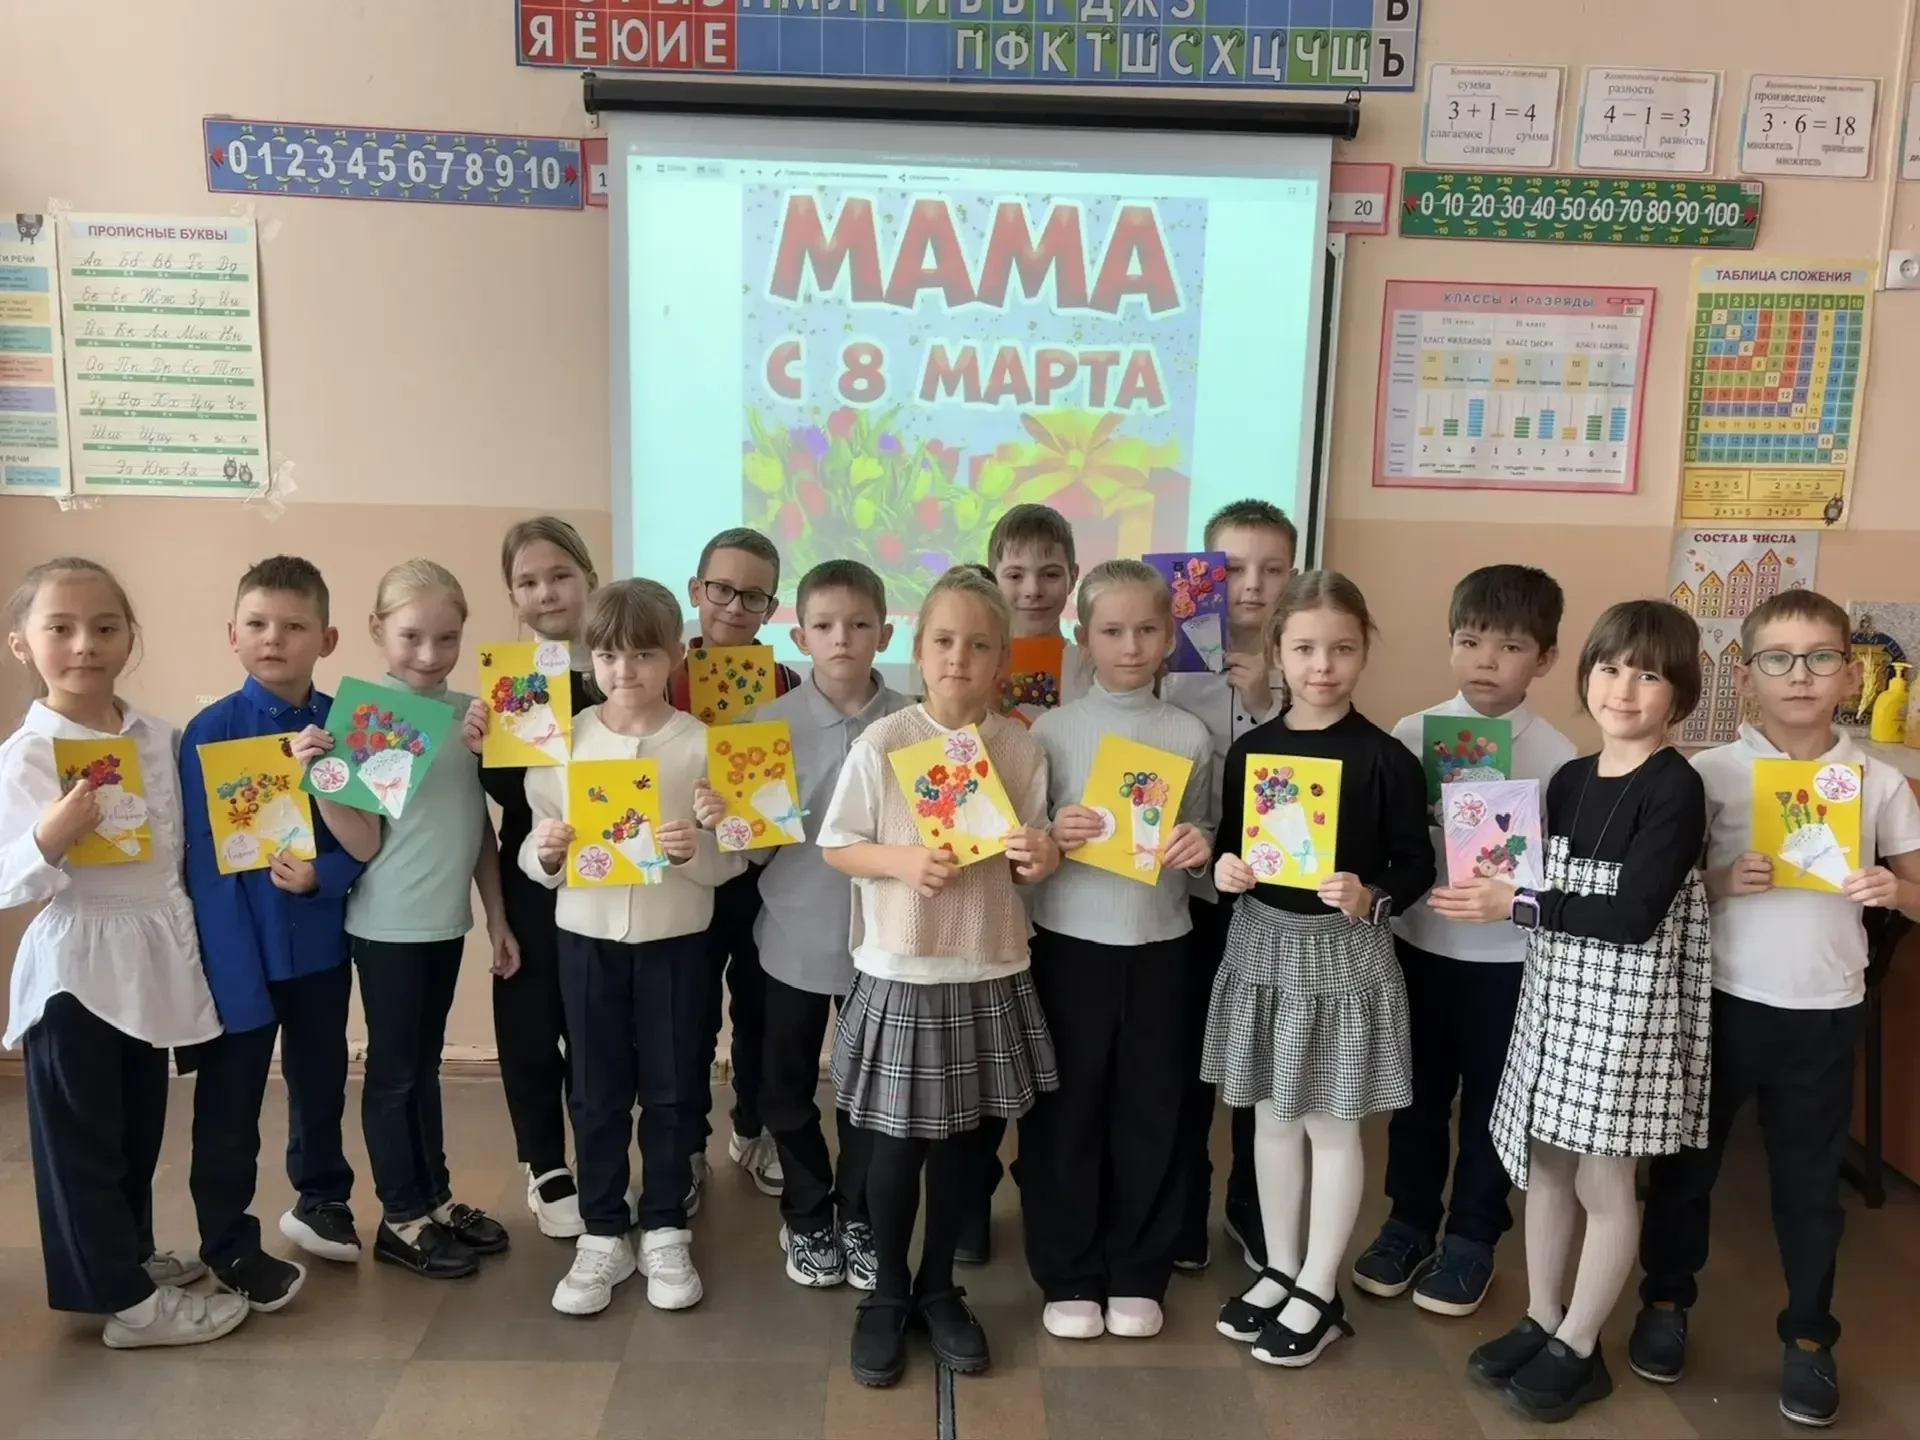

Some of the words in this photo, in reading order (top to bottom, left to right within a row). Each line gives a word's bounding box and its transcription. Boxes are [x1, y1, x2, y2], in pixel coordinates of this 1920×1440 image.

[528, 15, 554, 57] Я
[574, 11, 597, 59] Ё
[612, 20, 649, 62] Ю
[657, 20, 687, 62] И
[704, 22, 727, 64] Е
[956, 29, 983, 71] П
[994, 30, 1030, 72] Ф
[1042, 32, 1070, 73] К
[1086, 32, 1112, 73] Т
[1121, 33, 1157, 74] Ш
[1168, 33, 1197, 76] С
[1207, 34, 1239, 76] Х
[1252, 35, 1281, 82] Ц
[1295, 35, 1320, 77] Ч
[1331, 36, 1370, 83] Щ
[1378, 38, 1405, 77] Ъ
[1457, 80, 1491, 91] сумма
[1608, 85, 1654, 95] разность
[1754, 92, 1826, 103] произведение
[1430, 129, 1483, 139] слагаемое
[1516, 132, 1550, 142] сумма
[1463, 145, 1516, 155] слагаемое
[1613, 150, 1676, 160] вычитаемое
[228, 140, 247, 174] 0
[258, 142, 272, 175] 1
[286, 143, 306, 177] 2
[316, 145, 336, 178] 3
[347, 147, 366, 179] 4
[378, 149, 396, 181] 5
[408, 150, 427, 183] 6
[436, 152, 454, 184] 7
[465, 153, 484, 186] 8
[495, 155, 514, 187] 9
[524, 156, 560, 190] 10
[1496, 177, 1513, 185] +10
[1525, 178, 1542, 186] +10
[1640, 182, 1657, 190] +10
[1670, 183, 1686, 191] +10
[1700, 184, 1717, 192] +10
[1354, 200, 1372, 216] 20
[1421, 192, 1433, 215] 0
[1441, 193, 1464, 217] 10
[1470, 194, 1495, 218] 20
[1501, 195, 1525, 219] 30
[1530, 196, 1556, 220] 40
[1561, 197, 1586, 221] 50
[1589, 198, 1614, 222] 60
[1618, 199, 1643, 223] 70
[1646, 200, 1671, 224] 80
[1675, 201, 1700, 225] 90
[1705, 202, 1740, 227] 100
[88, 225, 176, 239] ПРОПИСНЫЕ
[180, 228, 228, 241] БУКВЫ
[11, 255, 36, 263] РЕЧИ
[768, 194, 1182, 314] МАМА
[1716, 270, 1776, 281] ТАБЛИЦА
[1781, 271, 1852, 282] СЛОЖЕНИЯ
[1443, 293, 1502, 305] КЛАССЫ
[1510, 296, 1518, 306] И
[1526, 296, 1594, 308] РАЗРЯДЫ
[1718, 297, 1724, 306] 1
[1733, 297, 1740, 306] 2
[1749, 297, 1755, 307] 3
[1763, 297, 1771, 307] 4
[1779, 298, 1786, 307] 5
[1794, 298, 1801, 307] 6
[1810, 298, 1816, 307] 7
[1825, 298, 1831, 308] 8
[1839, 298, 1846, 308] 9
[1852, 298, 1863, 308] 10
[766, 341, 801, 399] С
[838, 342, 886, 403] 8
[920, 344, 1166, 409] МАРТА
[1694, 534, 1748, 543] СОСТАВ
[1752, 534, 1796, 544] ЧИСЛА
